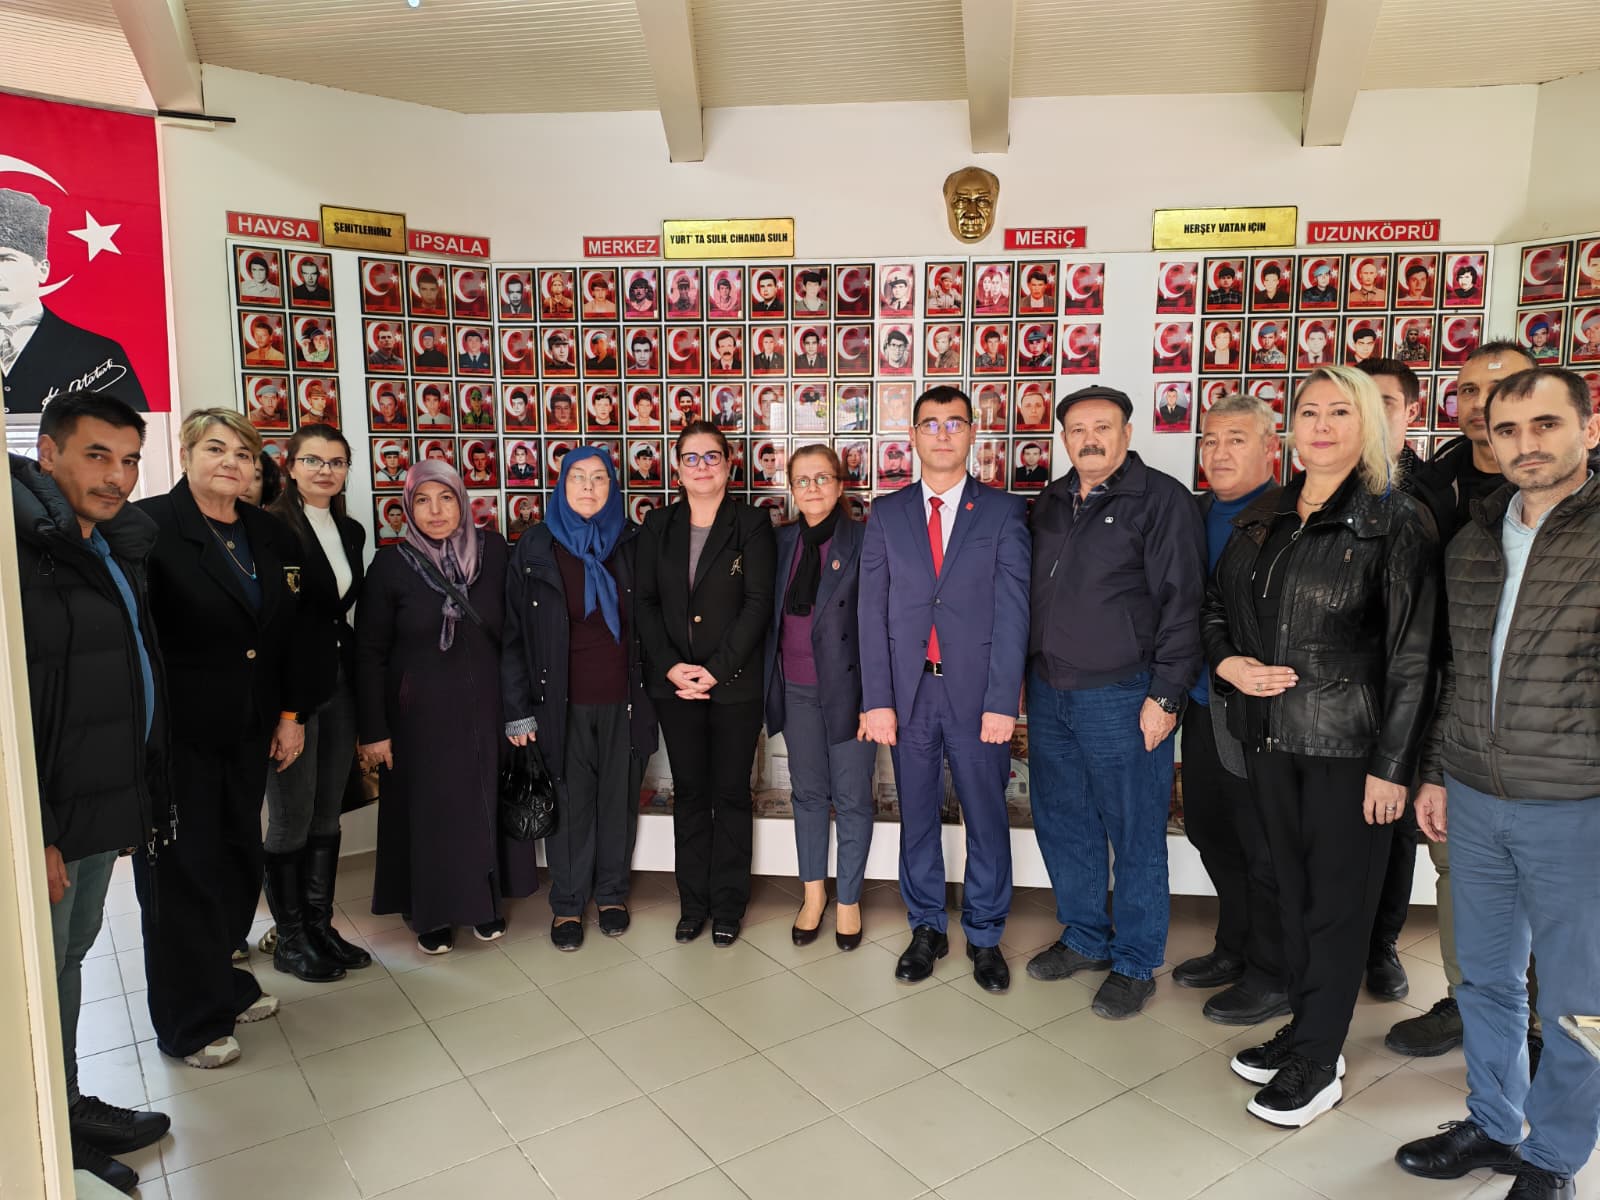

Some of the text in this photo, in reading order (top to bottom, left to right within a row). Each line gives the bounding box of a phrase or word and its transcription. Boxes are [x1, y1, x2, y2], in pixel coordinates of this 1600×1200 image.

[237, 215, 311, 239] HAVSA
[1183, 223, 1216, 235] HERŞEY
[1218, 222, 1247, 233] VATAN
[1314, 221, 1434, 241] UZUNKÖPRÜ
[695, 234, 705, 244] TA
[767, 232, 788, 242] SULH
[588, 239, 657, 254] MERKEZ
